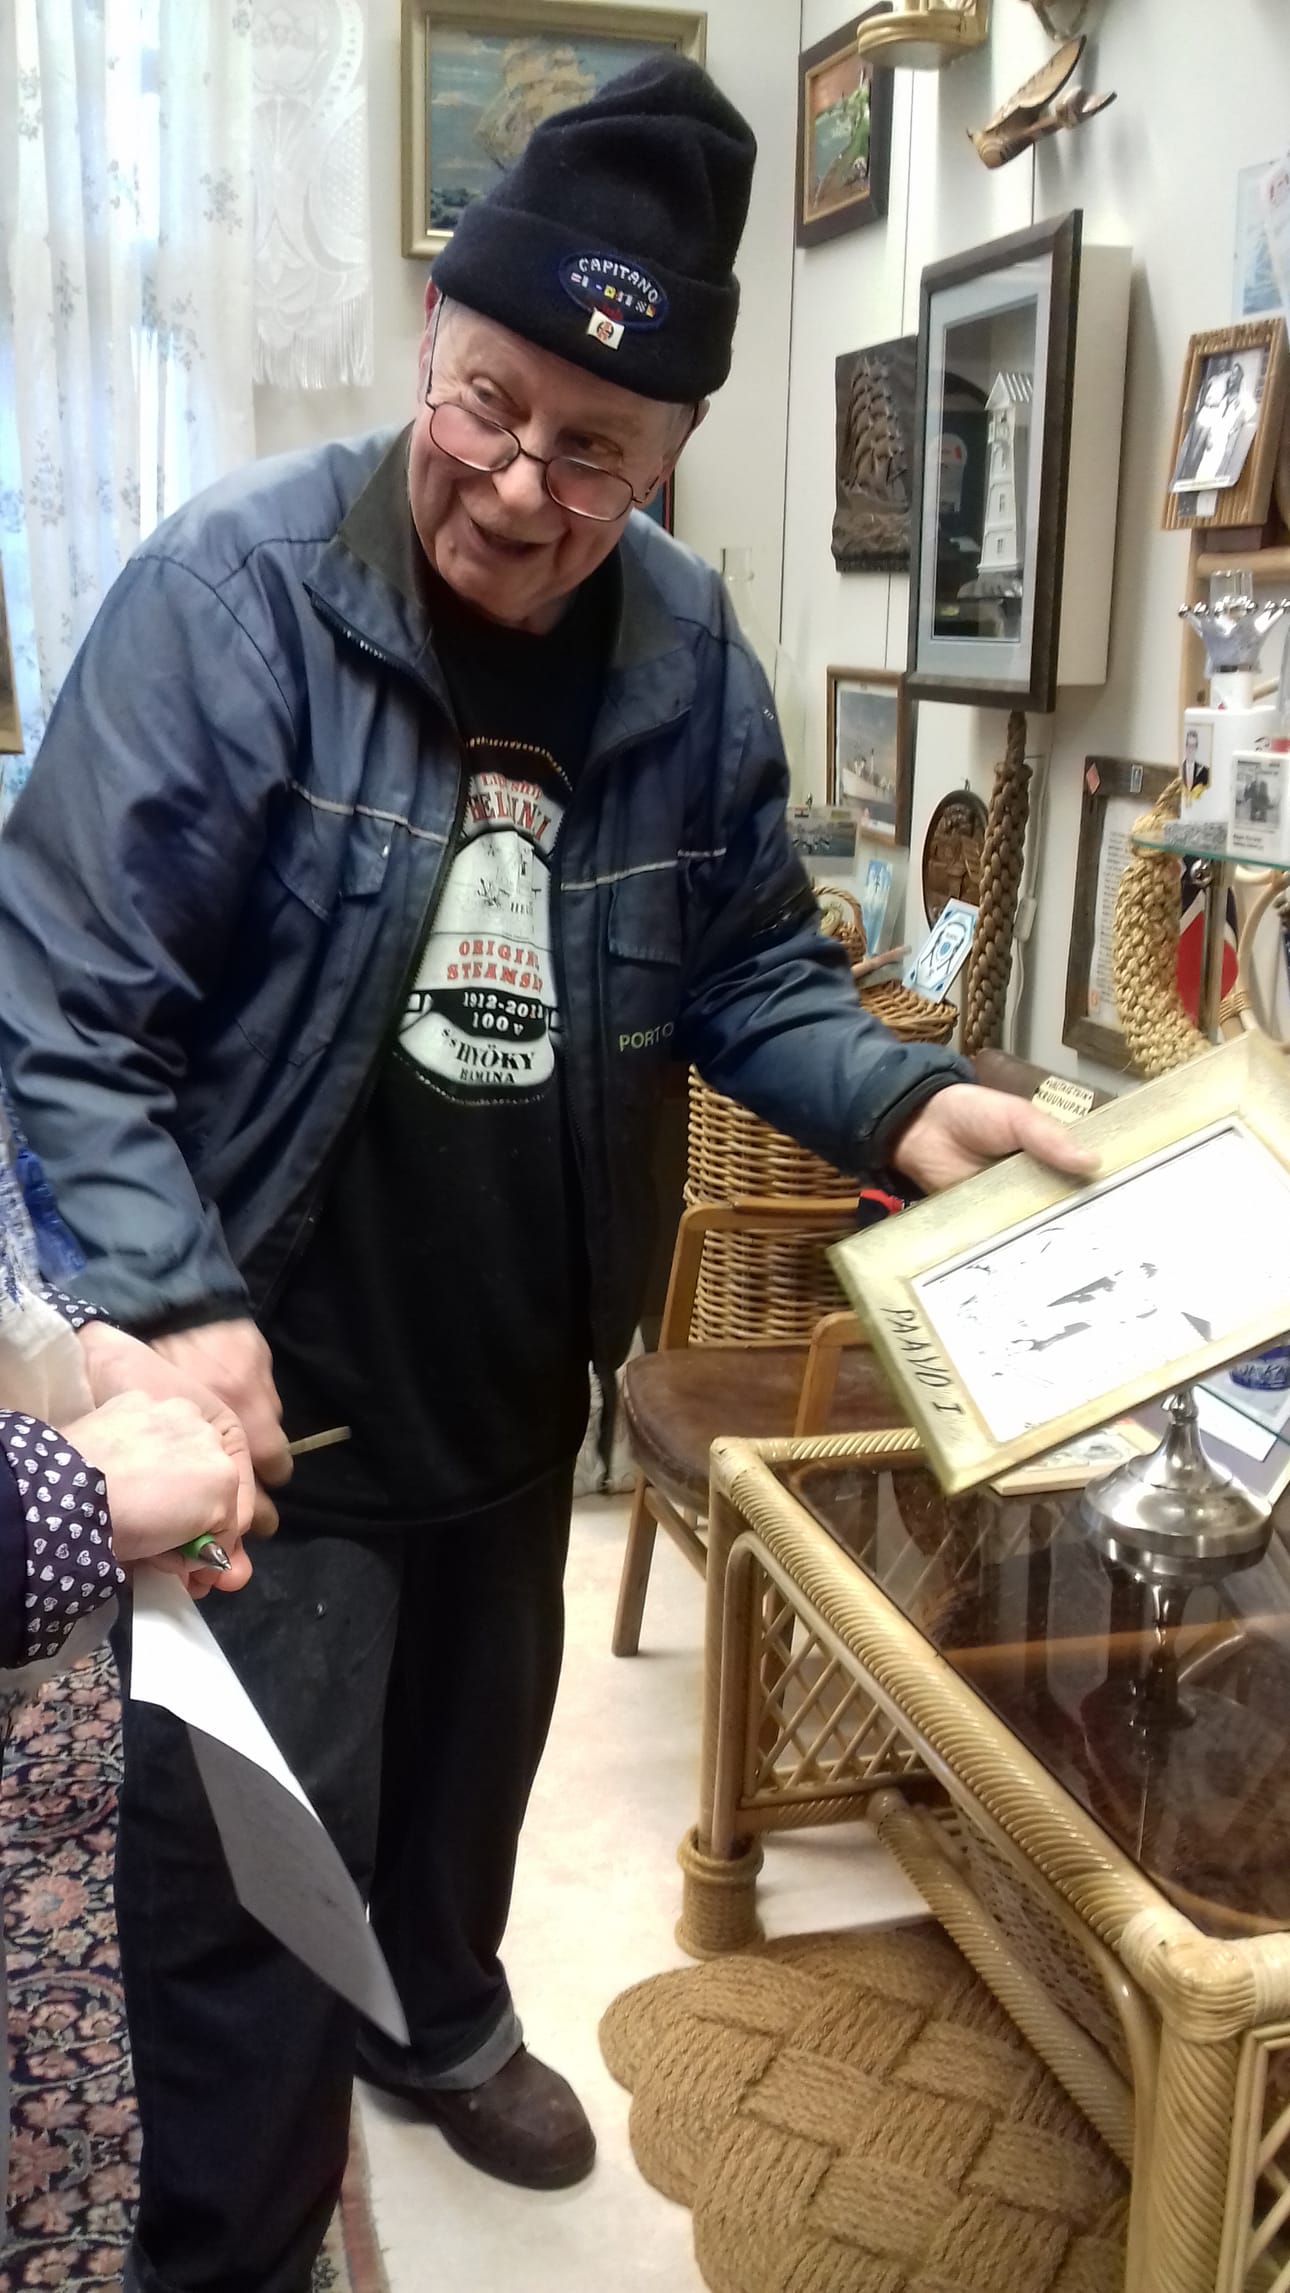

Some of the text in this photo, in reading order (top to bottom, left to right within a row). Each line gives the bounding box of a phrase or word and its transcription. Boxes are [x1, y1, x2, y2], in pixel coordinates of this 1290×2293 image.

[578, 257, 660, 304] CAPITANO
[472, 1011, 509, 1032] 100
[619, 1022, 674, 1052] PORTO
[879, 1304, 953, 1388] PAAVO
